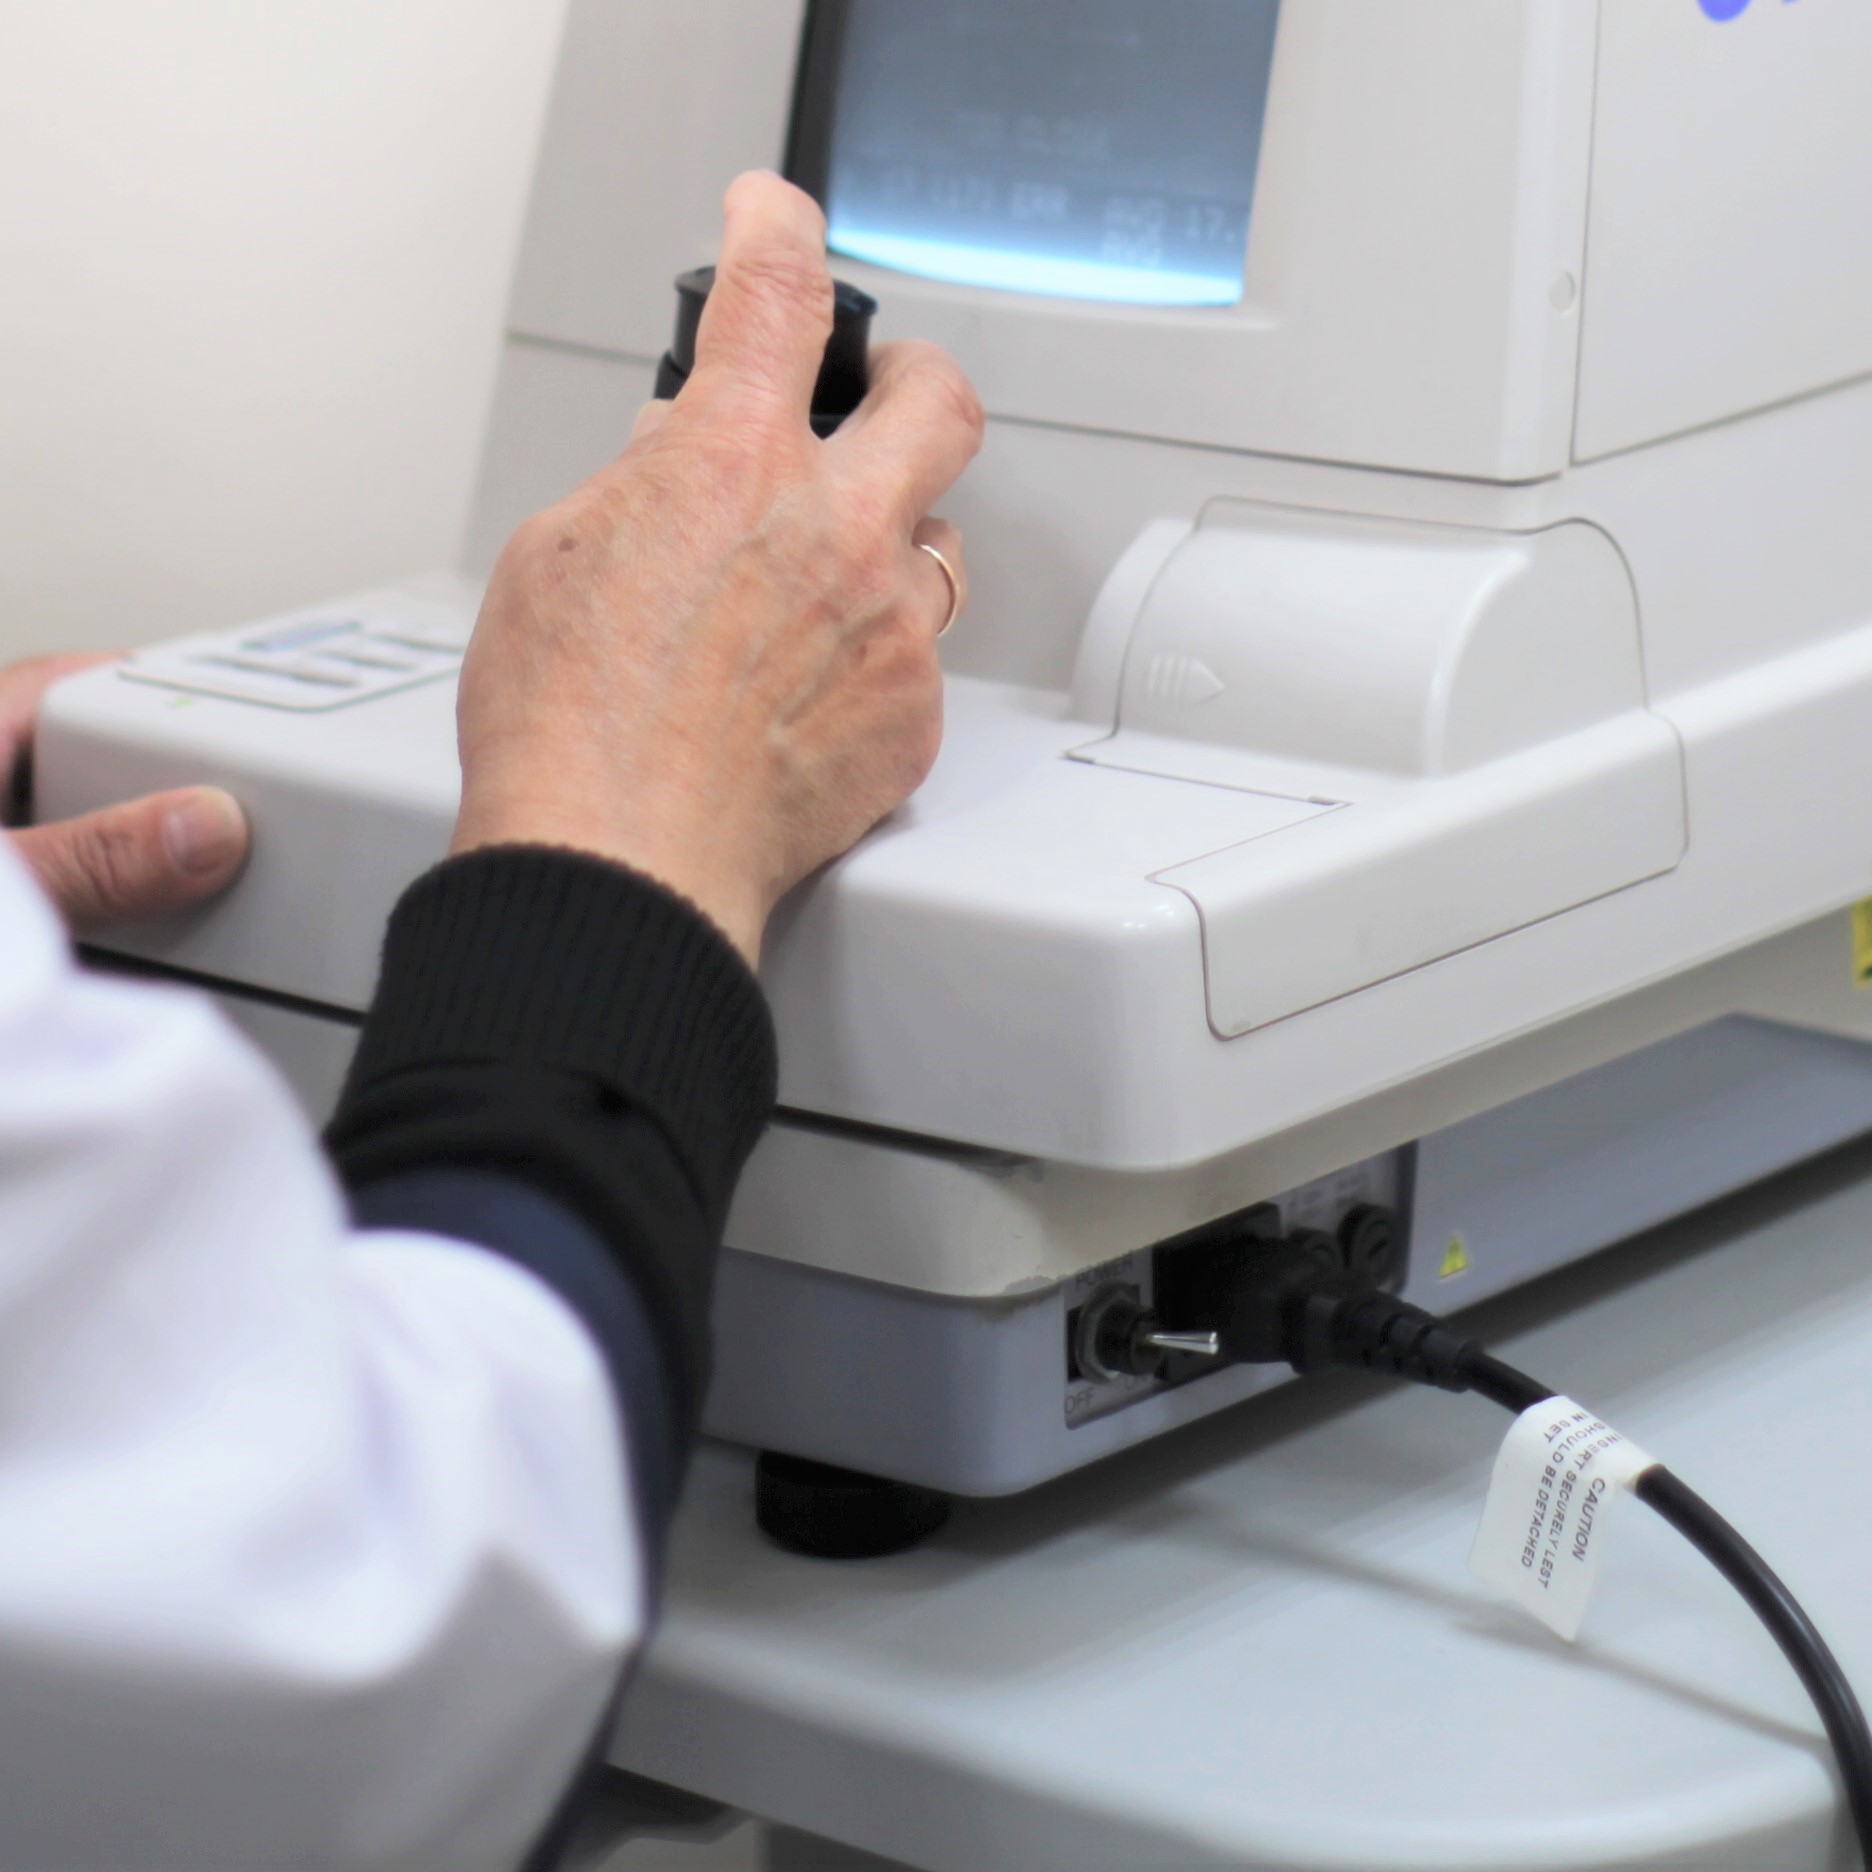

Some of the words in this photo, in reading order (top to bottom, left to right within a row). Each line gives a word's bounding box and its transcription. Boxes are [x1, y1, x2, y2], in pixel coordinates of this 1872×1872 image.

[1552, 1421, 1606, 1464] SHOULD
[1574, 1432, 1624, 1471] INSERT
[1541, 1465, 1557, 1489] BE
[1521, 1489, 1549, 1568] DETACHED
[1548, 1470, 1577, 1550] SECURELY
[1572, 1477, 1606, 1563] CAUTION
[1537, 1549, 1556, 1589] LEST
